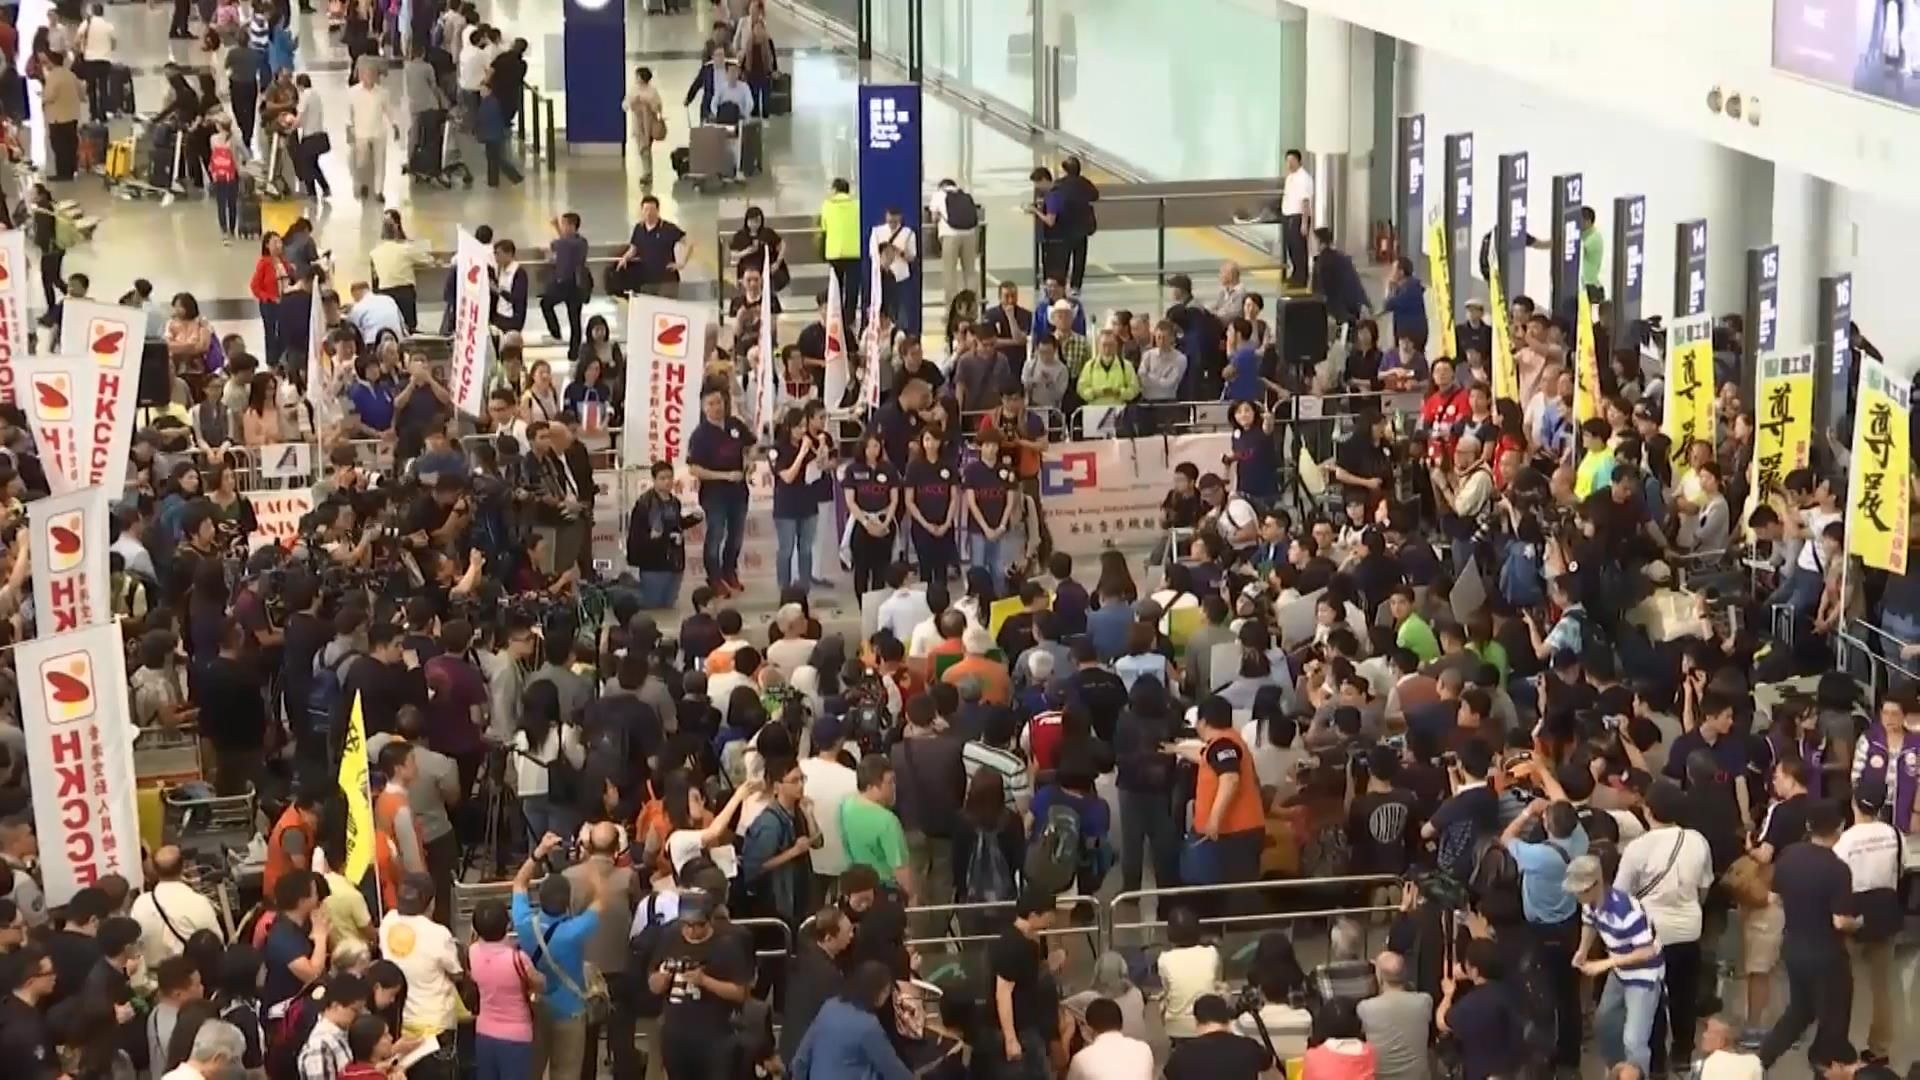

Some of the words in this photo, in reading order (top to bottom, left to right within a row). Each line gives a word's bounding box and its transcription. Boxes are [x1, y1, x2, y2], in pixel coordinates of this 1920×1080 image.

[1412, 119, 1422, 140] 9
[1459, 137, 1472, 159] 10
[1514, 158, 1526, 180] 11
[1567, 178, 1581, 202] 12
[1629, 201, 1644, 226] 13
[1692, 225, 1705, 251] 14
[1762, 252, 1777, 278] 15
[1836, 279, 1850, 307] 16
[1858, 402, 1896, 533] 尊嚴
